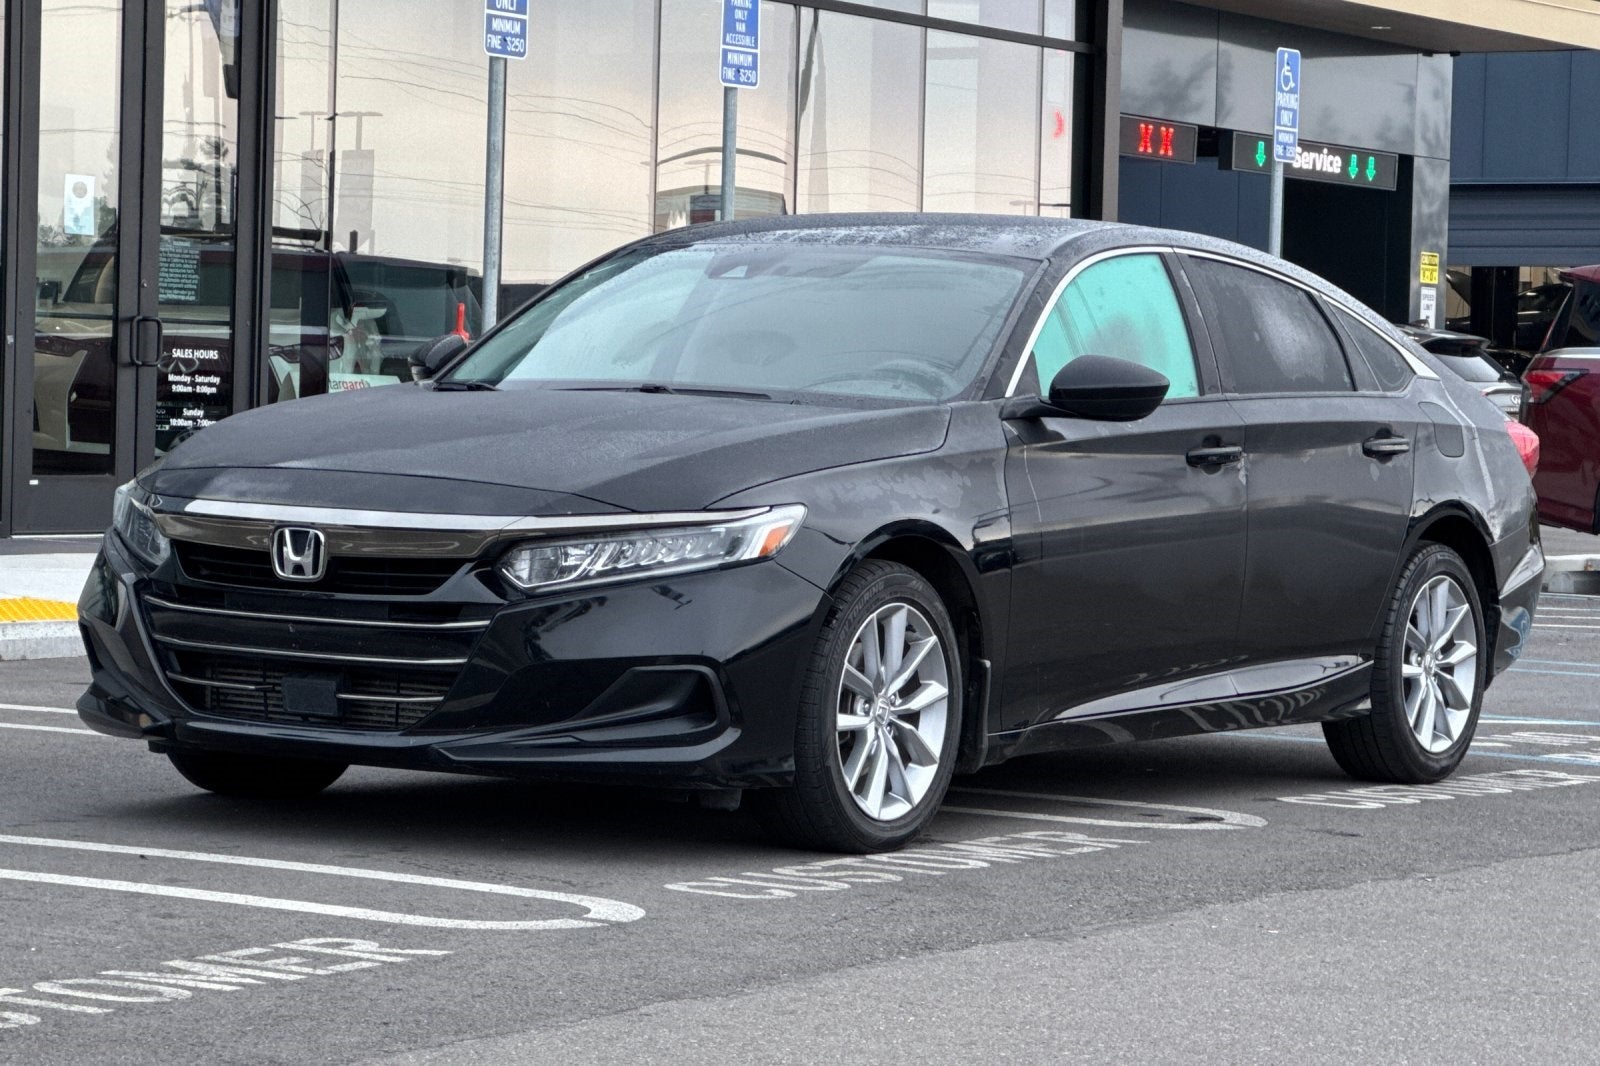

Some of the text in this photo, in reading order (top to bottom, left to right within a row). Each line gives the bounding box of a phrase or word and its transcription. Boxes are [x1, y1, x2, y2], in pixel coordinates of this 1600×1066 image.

[734, 9, 748, 21] ONLY
[491, 17, 521, 35] MINIMUM
[735, 21, 746, 33] VAN
[486, 34, 525, 53] FINE $250
[725, 33, 755, 47] ACCESSIBLE
[727, 51, 753, 67] MINIMUM
[722, 66, 757, 83] FINE $250
[1293, 147, 1342, 174] Service
[172, 348, 219, 360] SALES HOURS
[168, 373, 191, 384] Monday
[194, 374, 221, 386] Saturday
[171, 384, 193, 393] 9:00am
[196, 385, 217, 395] 8:00pm
[182, 407, 204, 418] Sunday
[663, 831, 1151, 899] CUSTOMER
